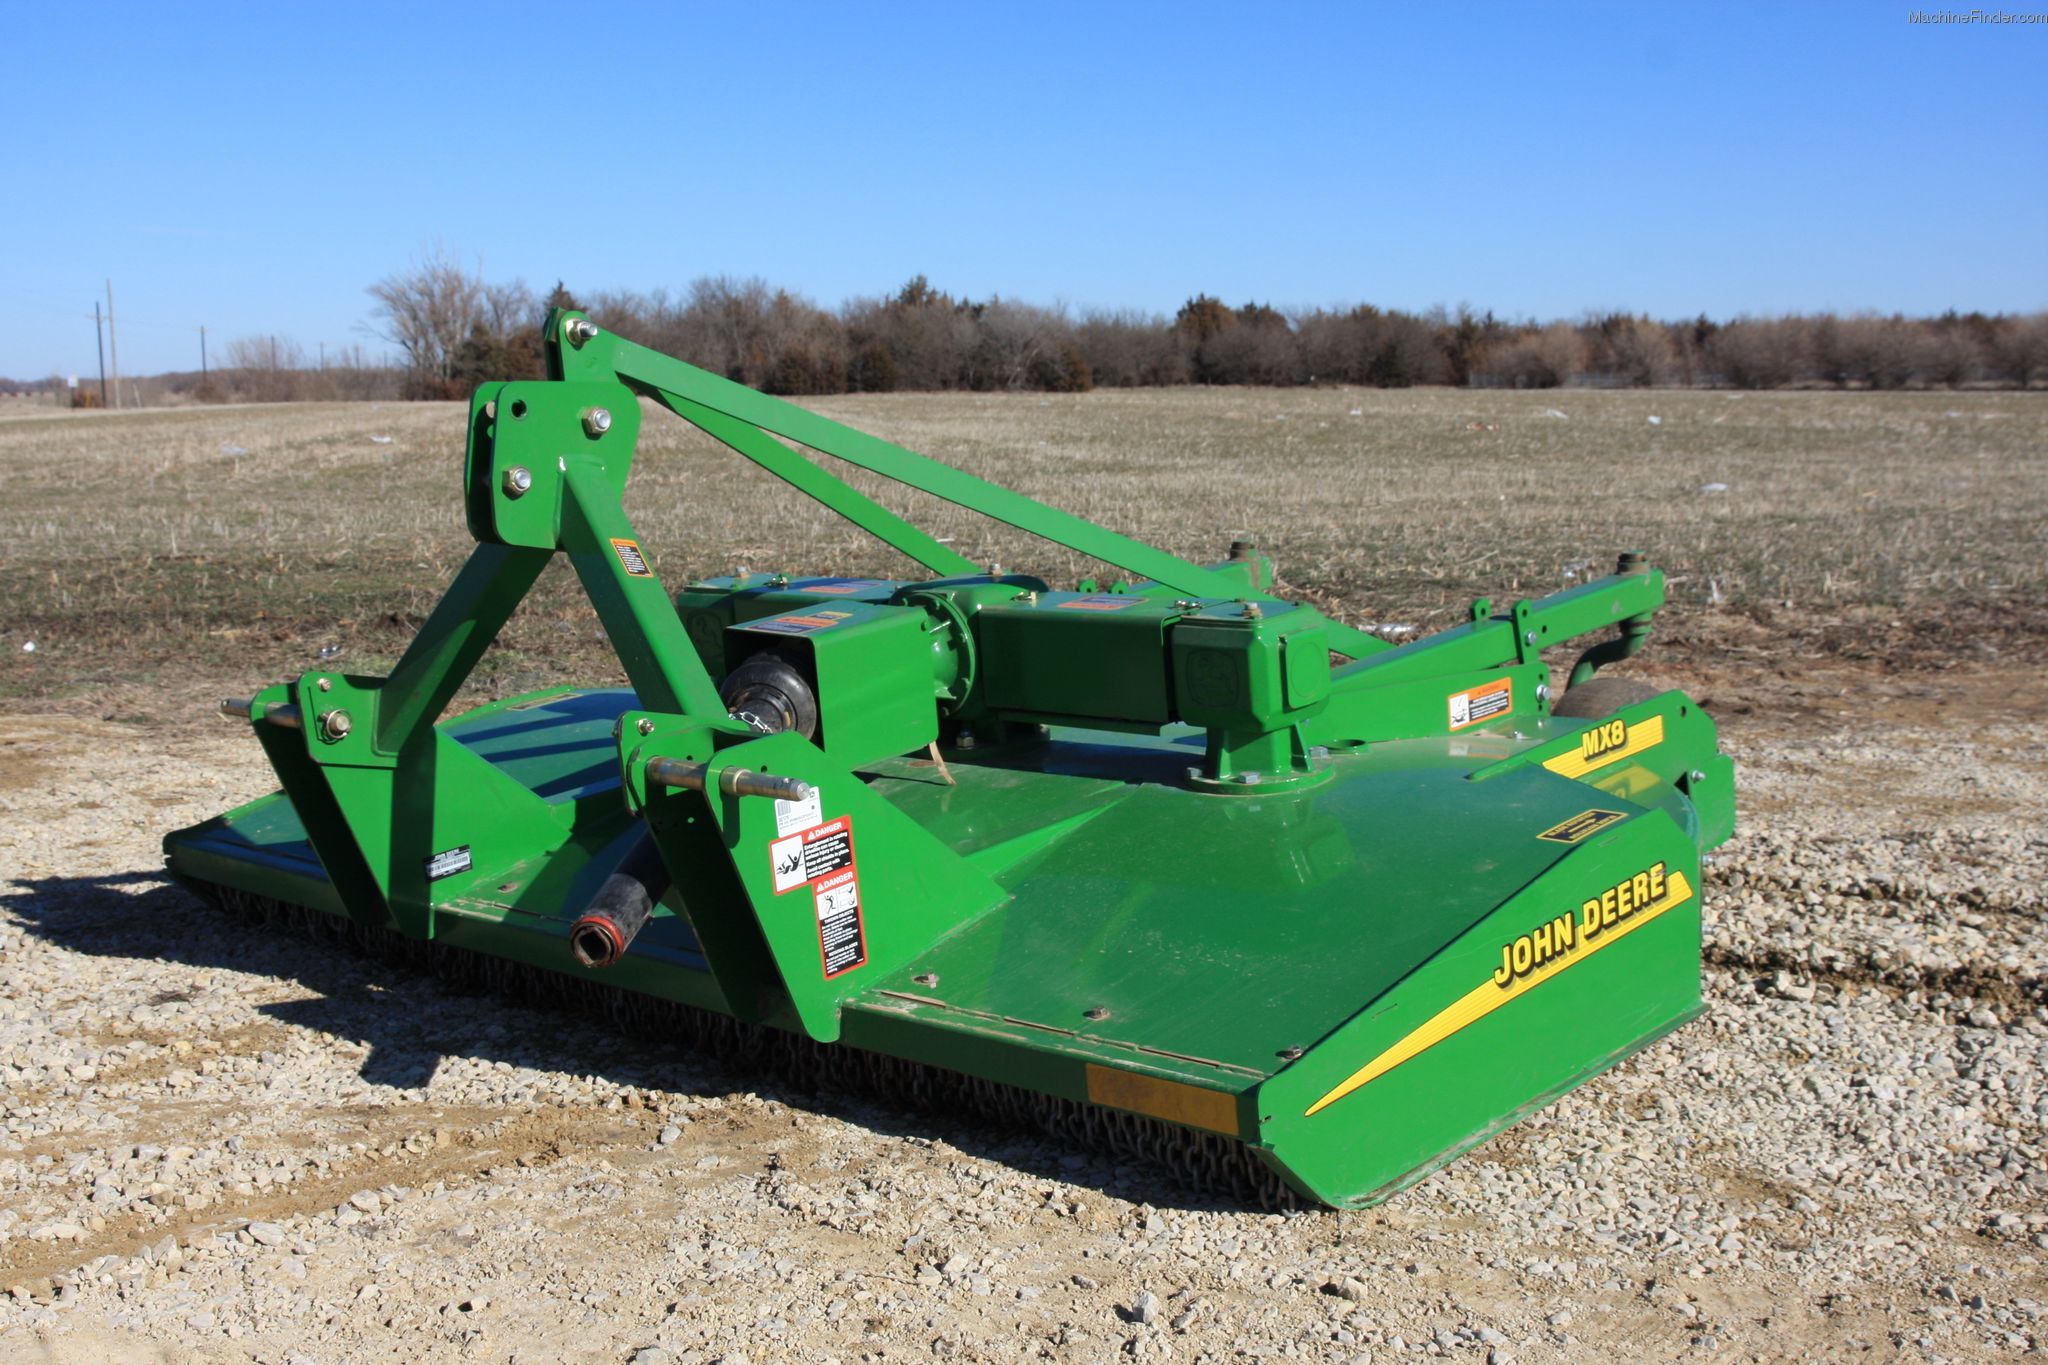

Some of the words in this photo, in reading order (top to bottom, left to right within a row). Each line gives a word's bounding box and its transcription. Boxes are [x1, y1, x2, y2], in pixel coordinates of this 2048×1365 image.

[1582, 718, 1627, 762] MX8
[815, 821, 841, 837] DANGER
[824, 870, 853, 888] DANGER
[1494, 910, 1574, 988] JOHN
[1583, 860, 1667, 940] DEERE
